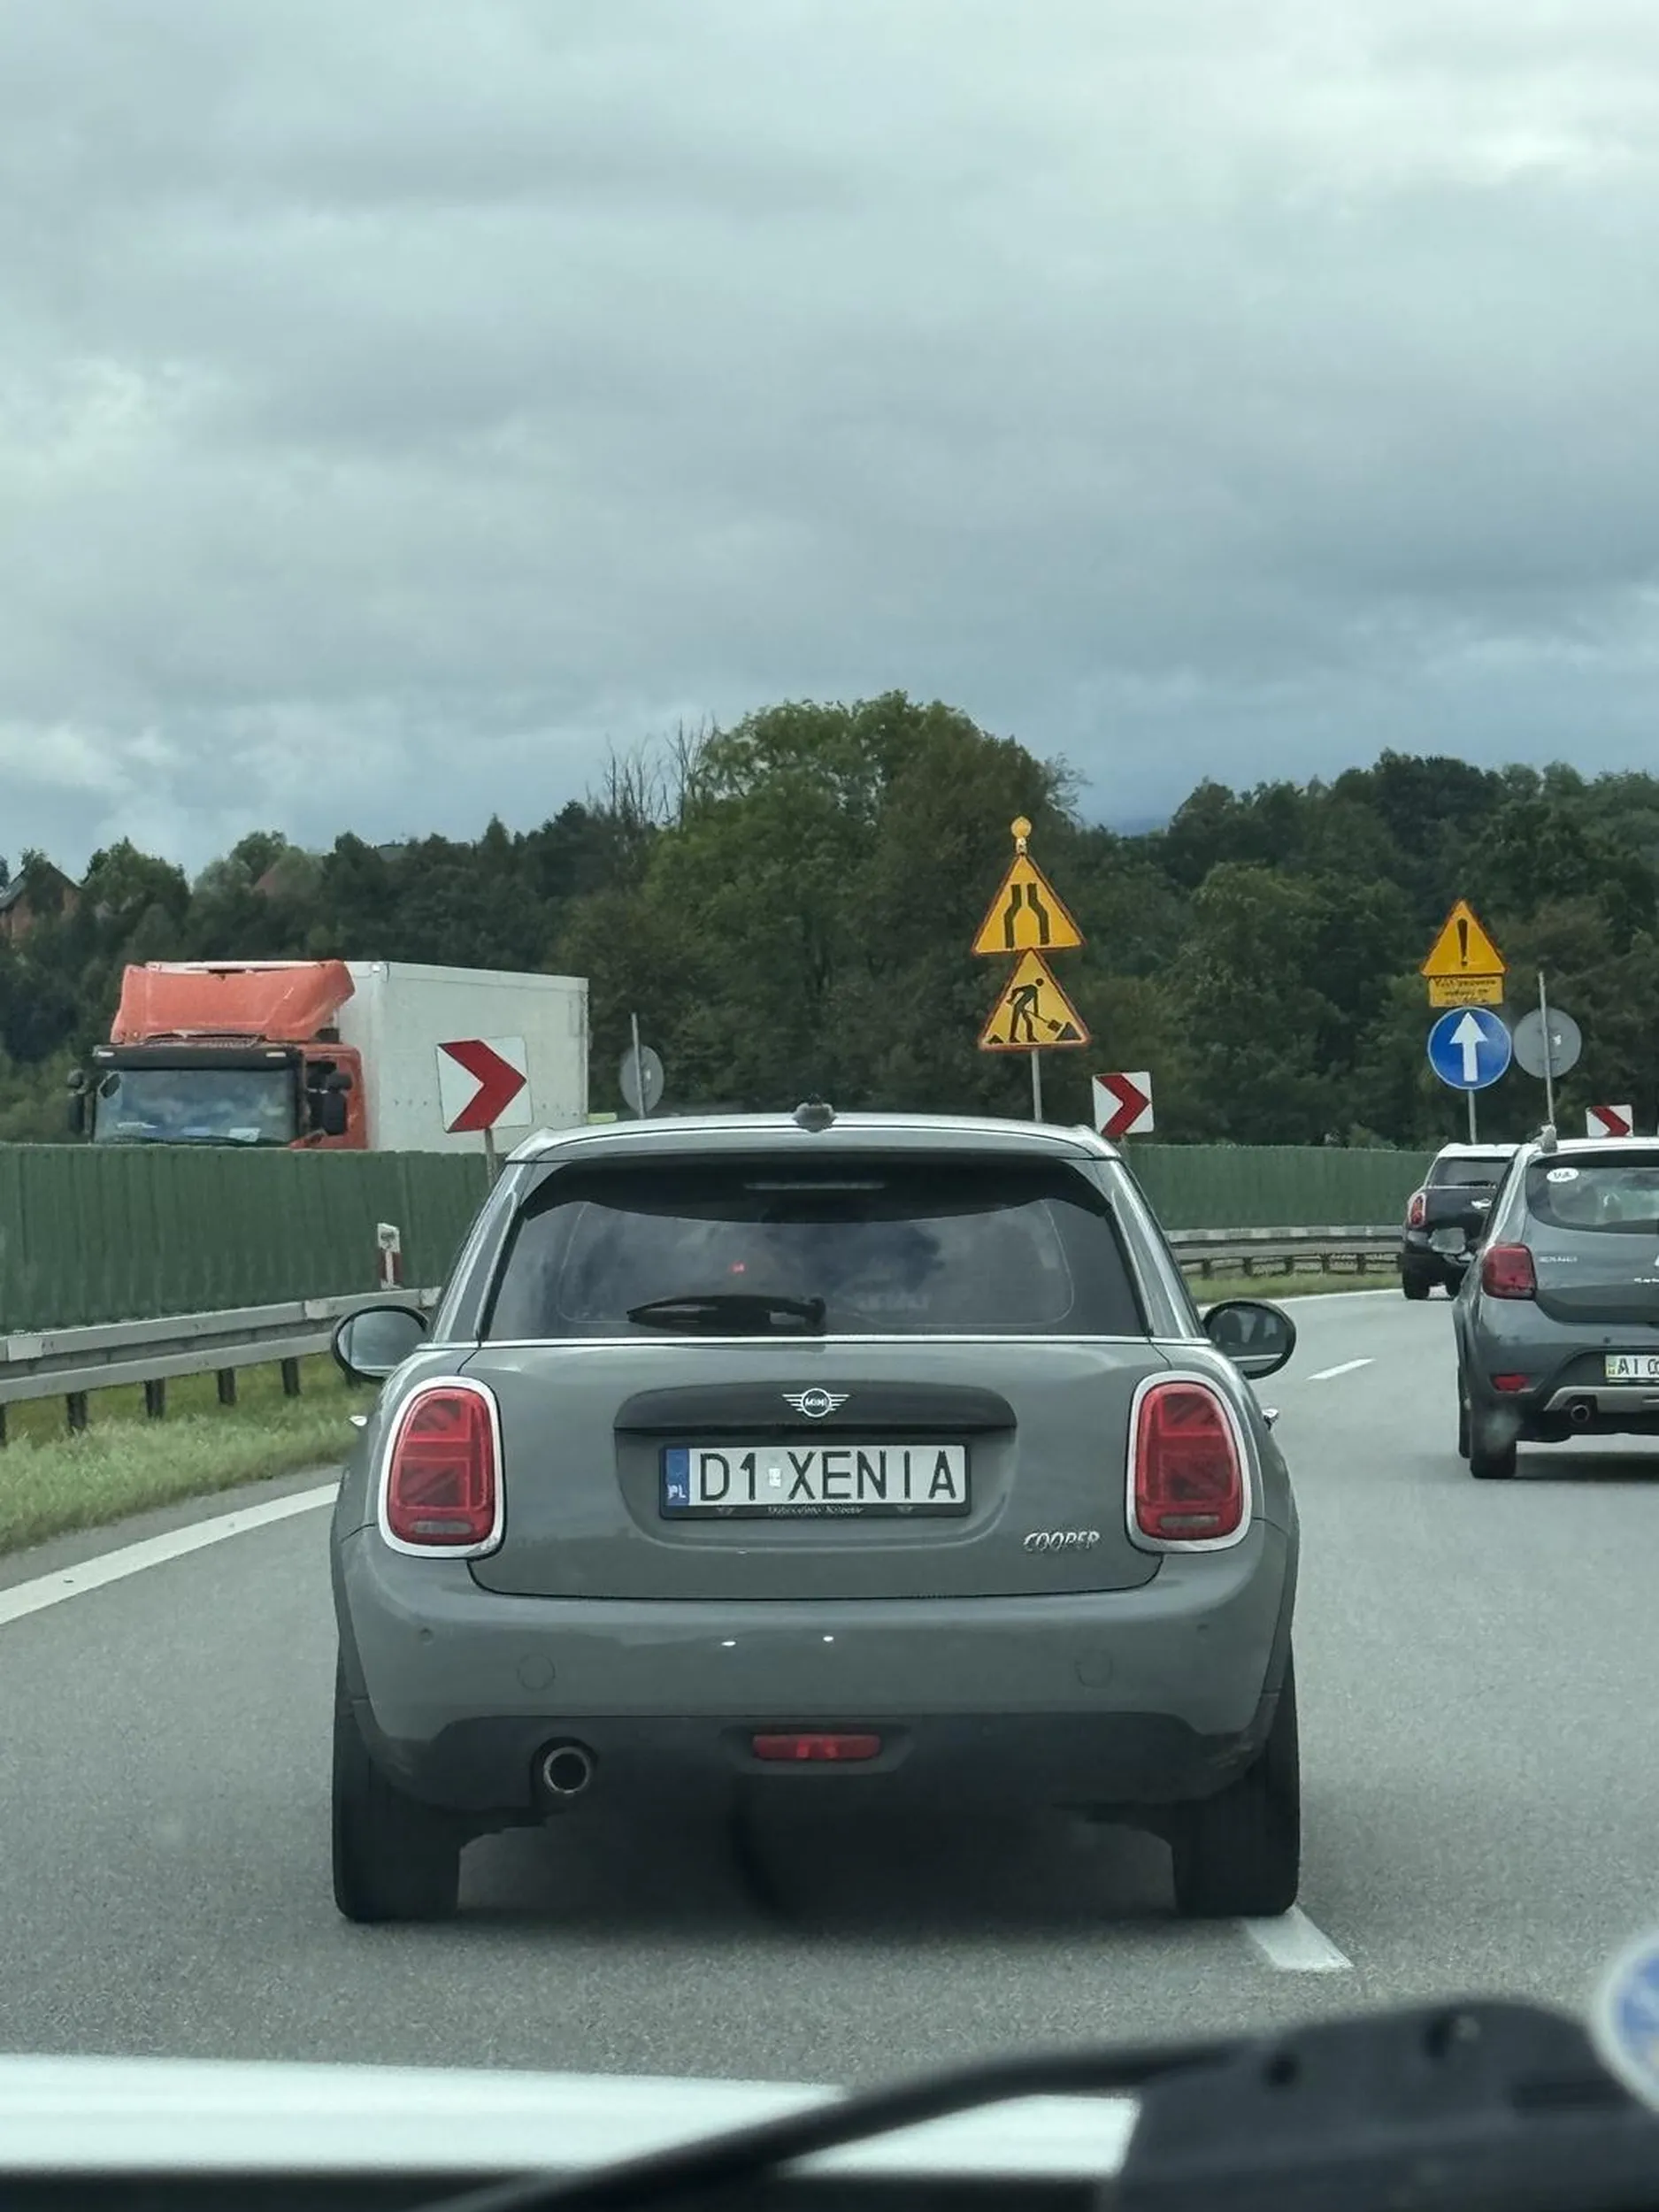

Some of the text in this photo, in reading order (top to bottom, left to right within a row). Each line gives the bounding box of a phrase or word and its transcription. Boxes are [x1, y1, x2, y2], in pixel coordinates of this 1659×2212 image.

[700, 1450, 956, 1501] D1 XENIA
[668, 1485, 686, 1499] PL
[1023, 1531, 1100, 1550] COOPER
